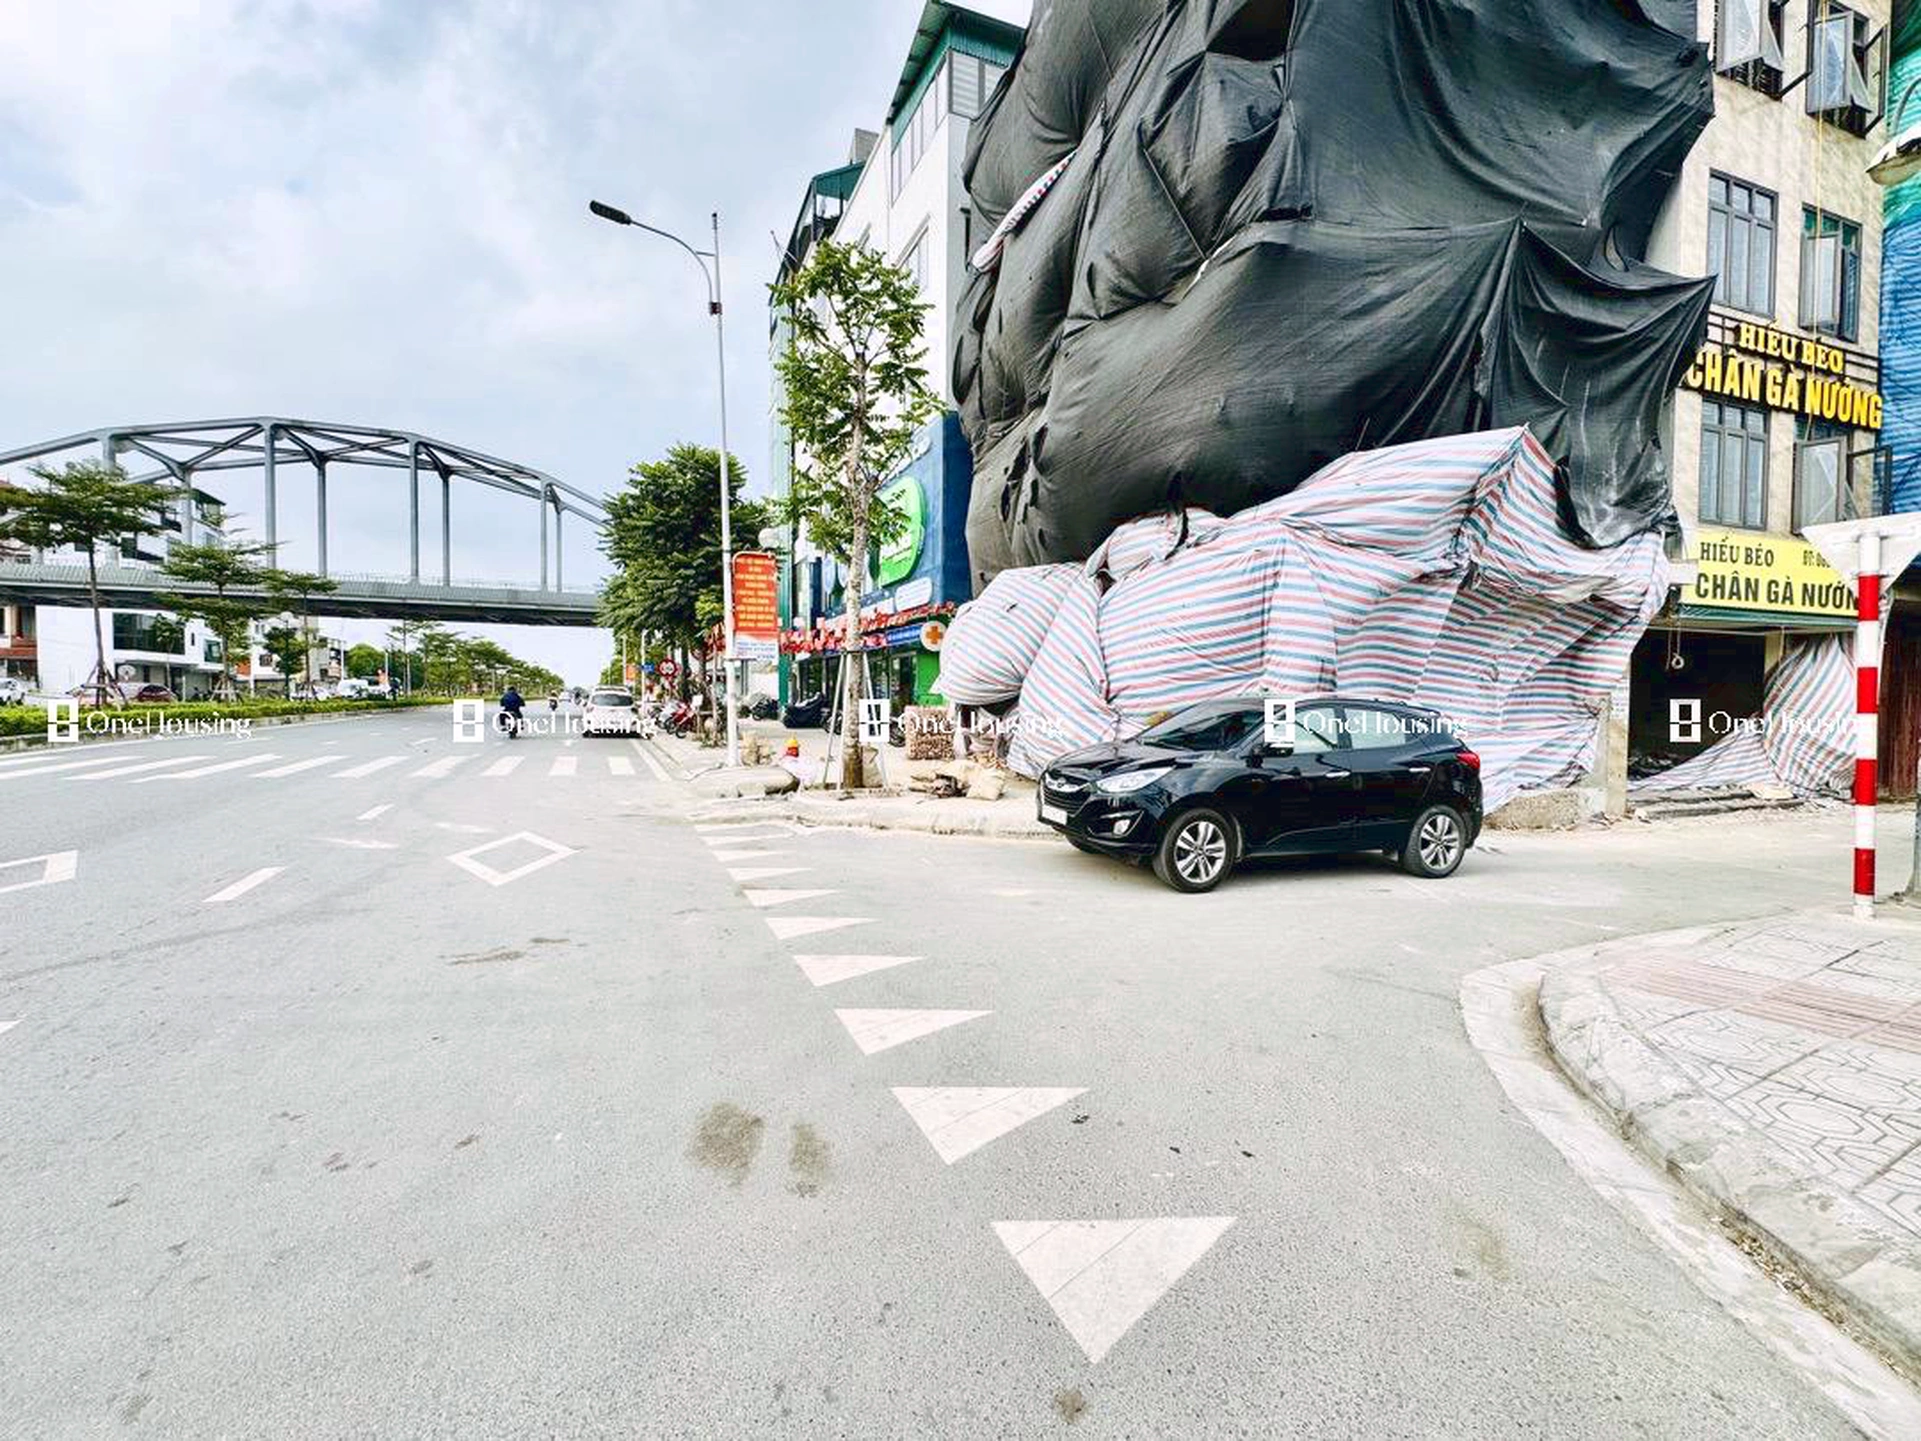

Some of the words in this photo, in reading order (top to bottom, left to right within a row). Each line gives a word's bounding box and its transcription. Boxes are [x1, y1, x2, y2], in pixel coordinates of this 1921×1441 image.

[1687, 346, 1764, 402] CHÂN
[1766, 364, 1799, 411] GÀ
[1700, 534, 1740, 565] HIẾU
[1744, 543, 1774, 567] BÉO
[1695, 571, 1759, 602] CHÂN
[1767, 575, 1794, 605] GÀ
[1801, 580, 1859, 610] NƯỚN
